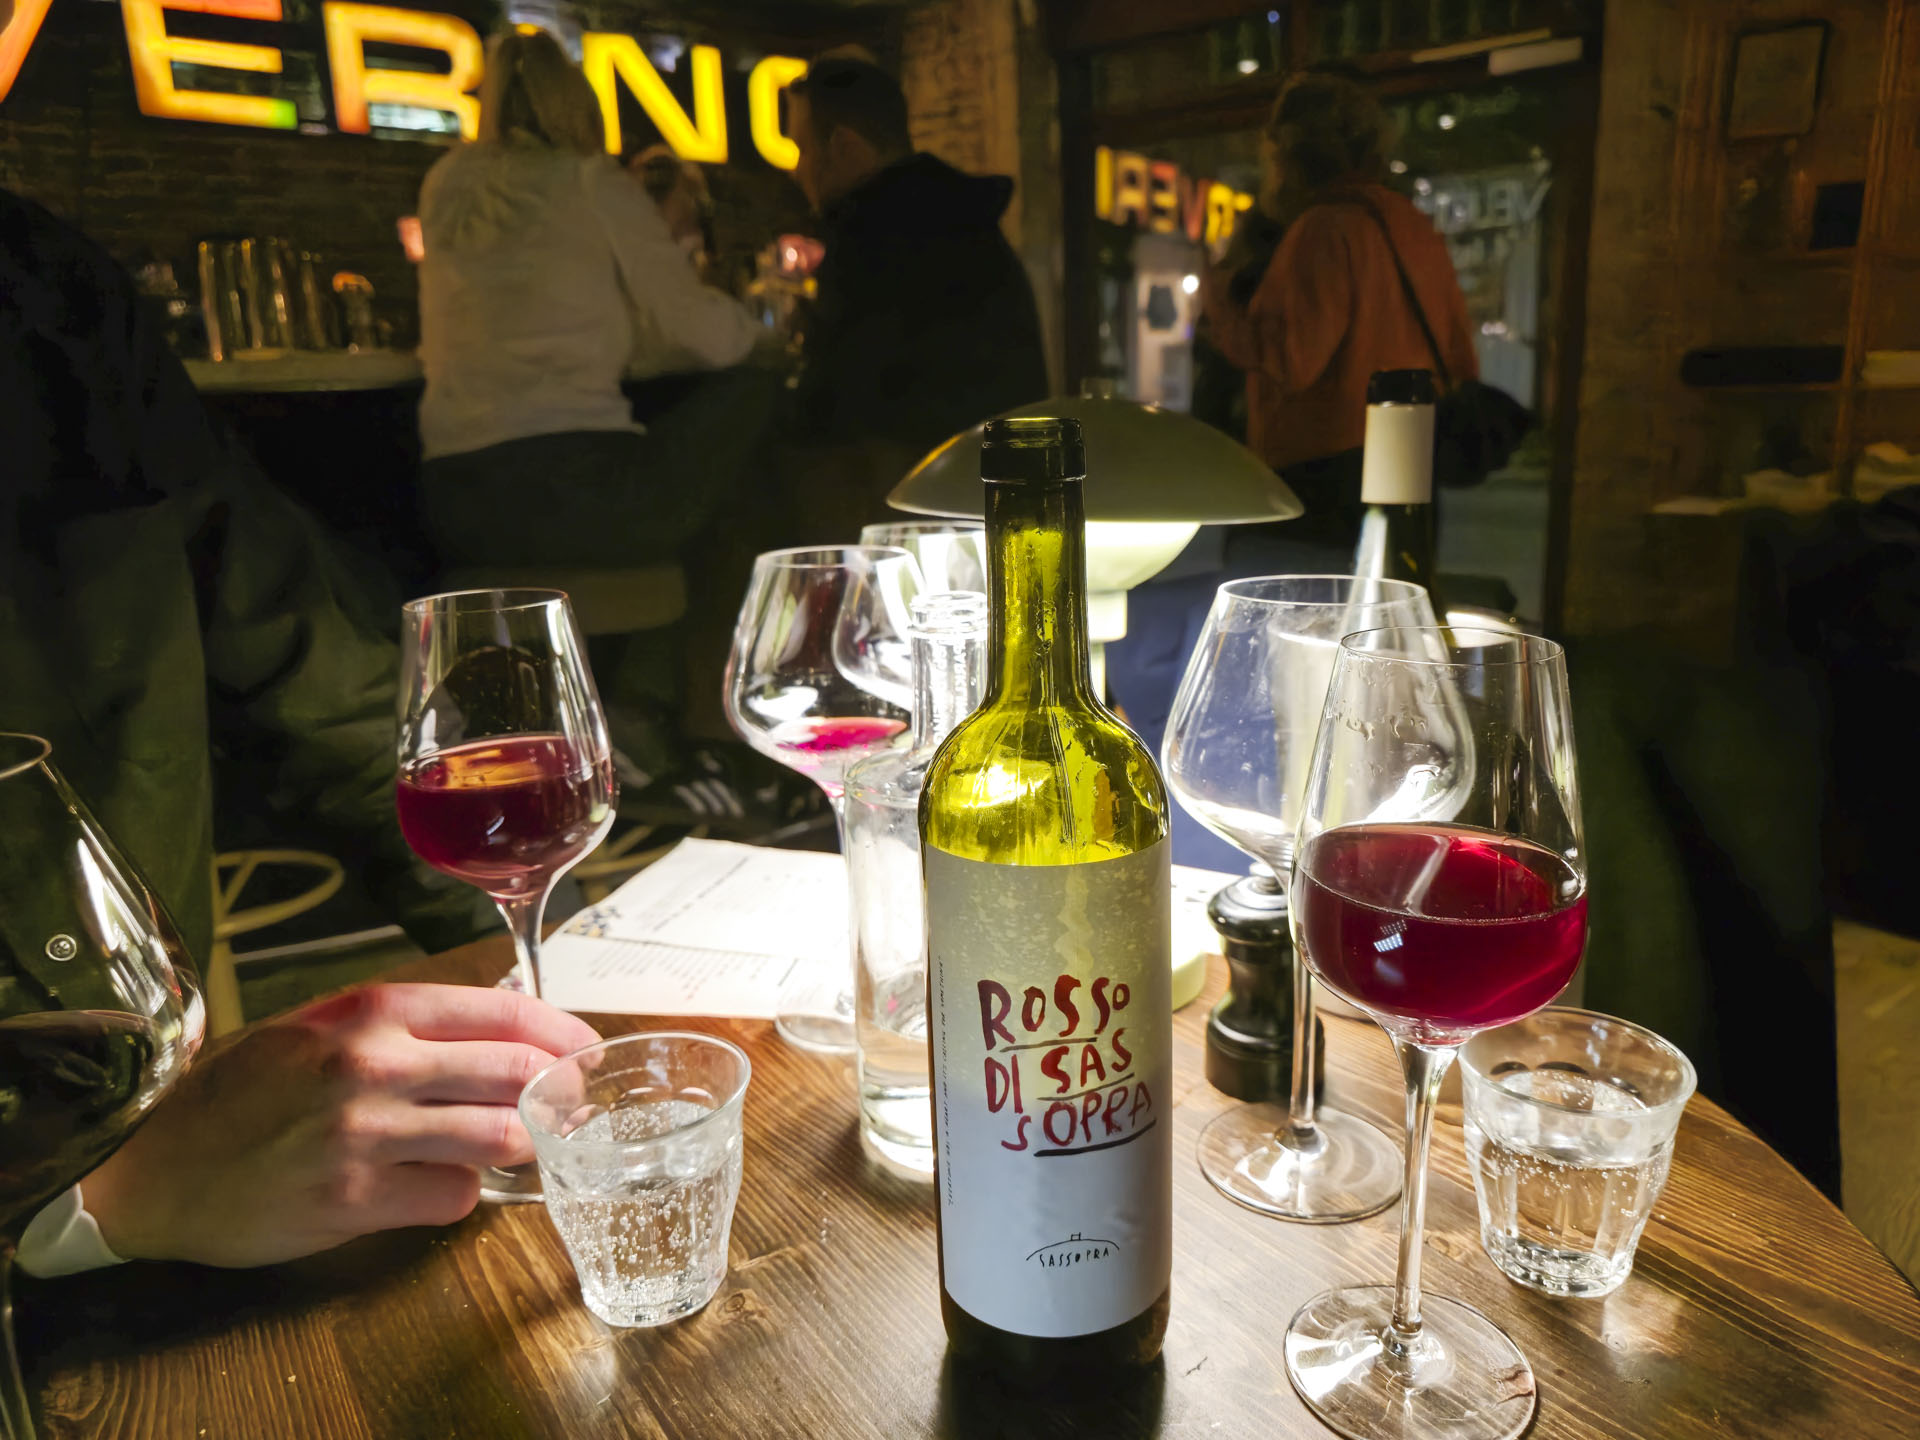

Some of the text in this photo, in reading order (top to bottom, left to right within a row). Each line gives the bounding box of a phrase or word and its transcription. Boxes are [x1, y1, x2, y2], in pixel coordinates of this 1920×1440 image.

[977, 974, 1131, 1051] ROSSO
[984, 1028, 1133, 1114] DI SAS
[1001, 1081, 1152, 1151] SOPRA
[1039, 1247, 1110, 1268] SASSOPRA
